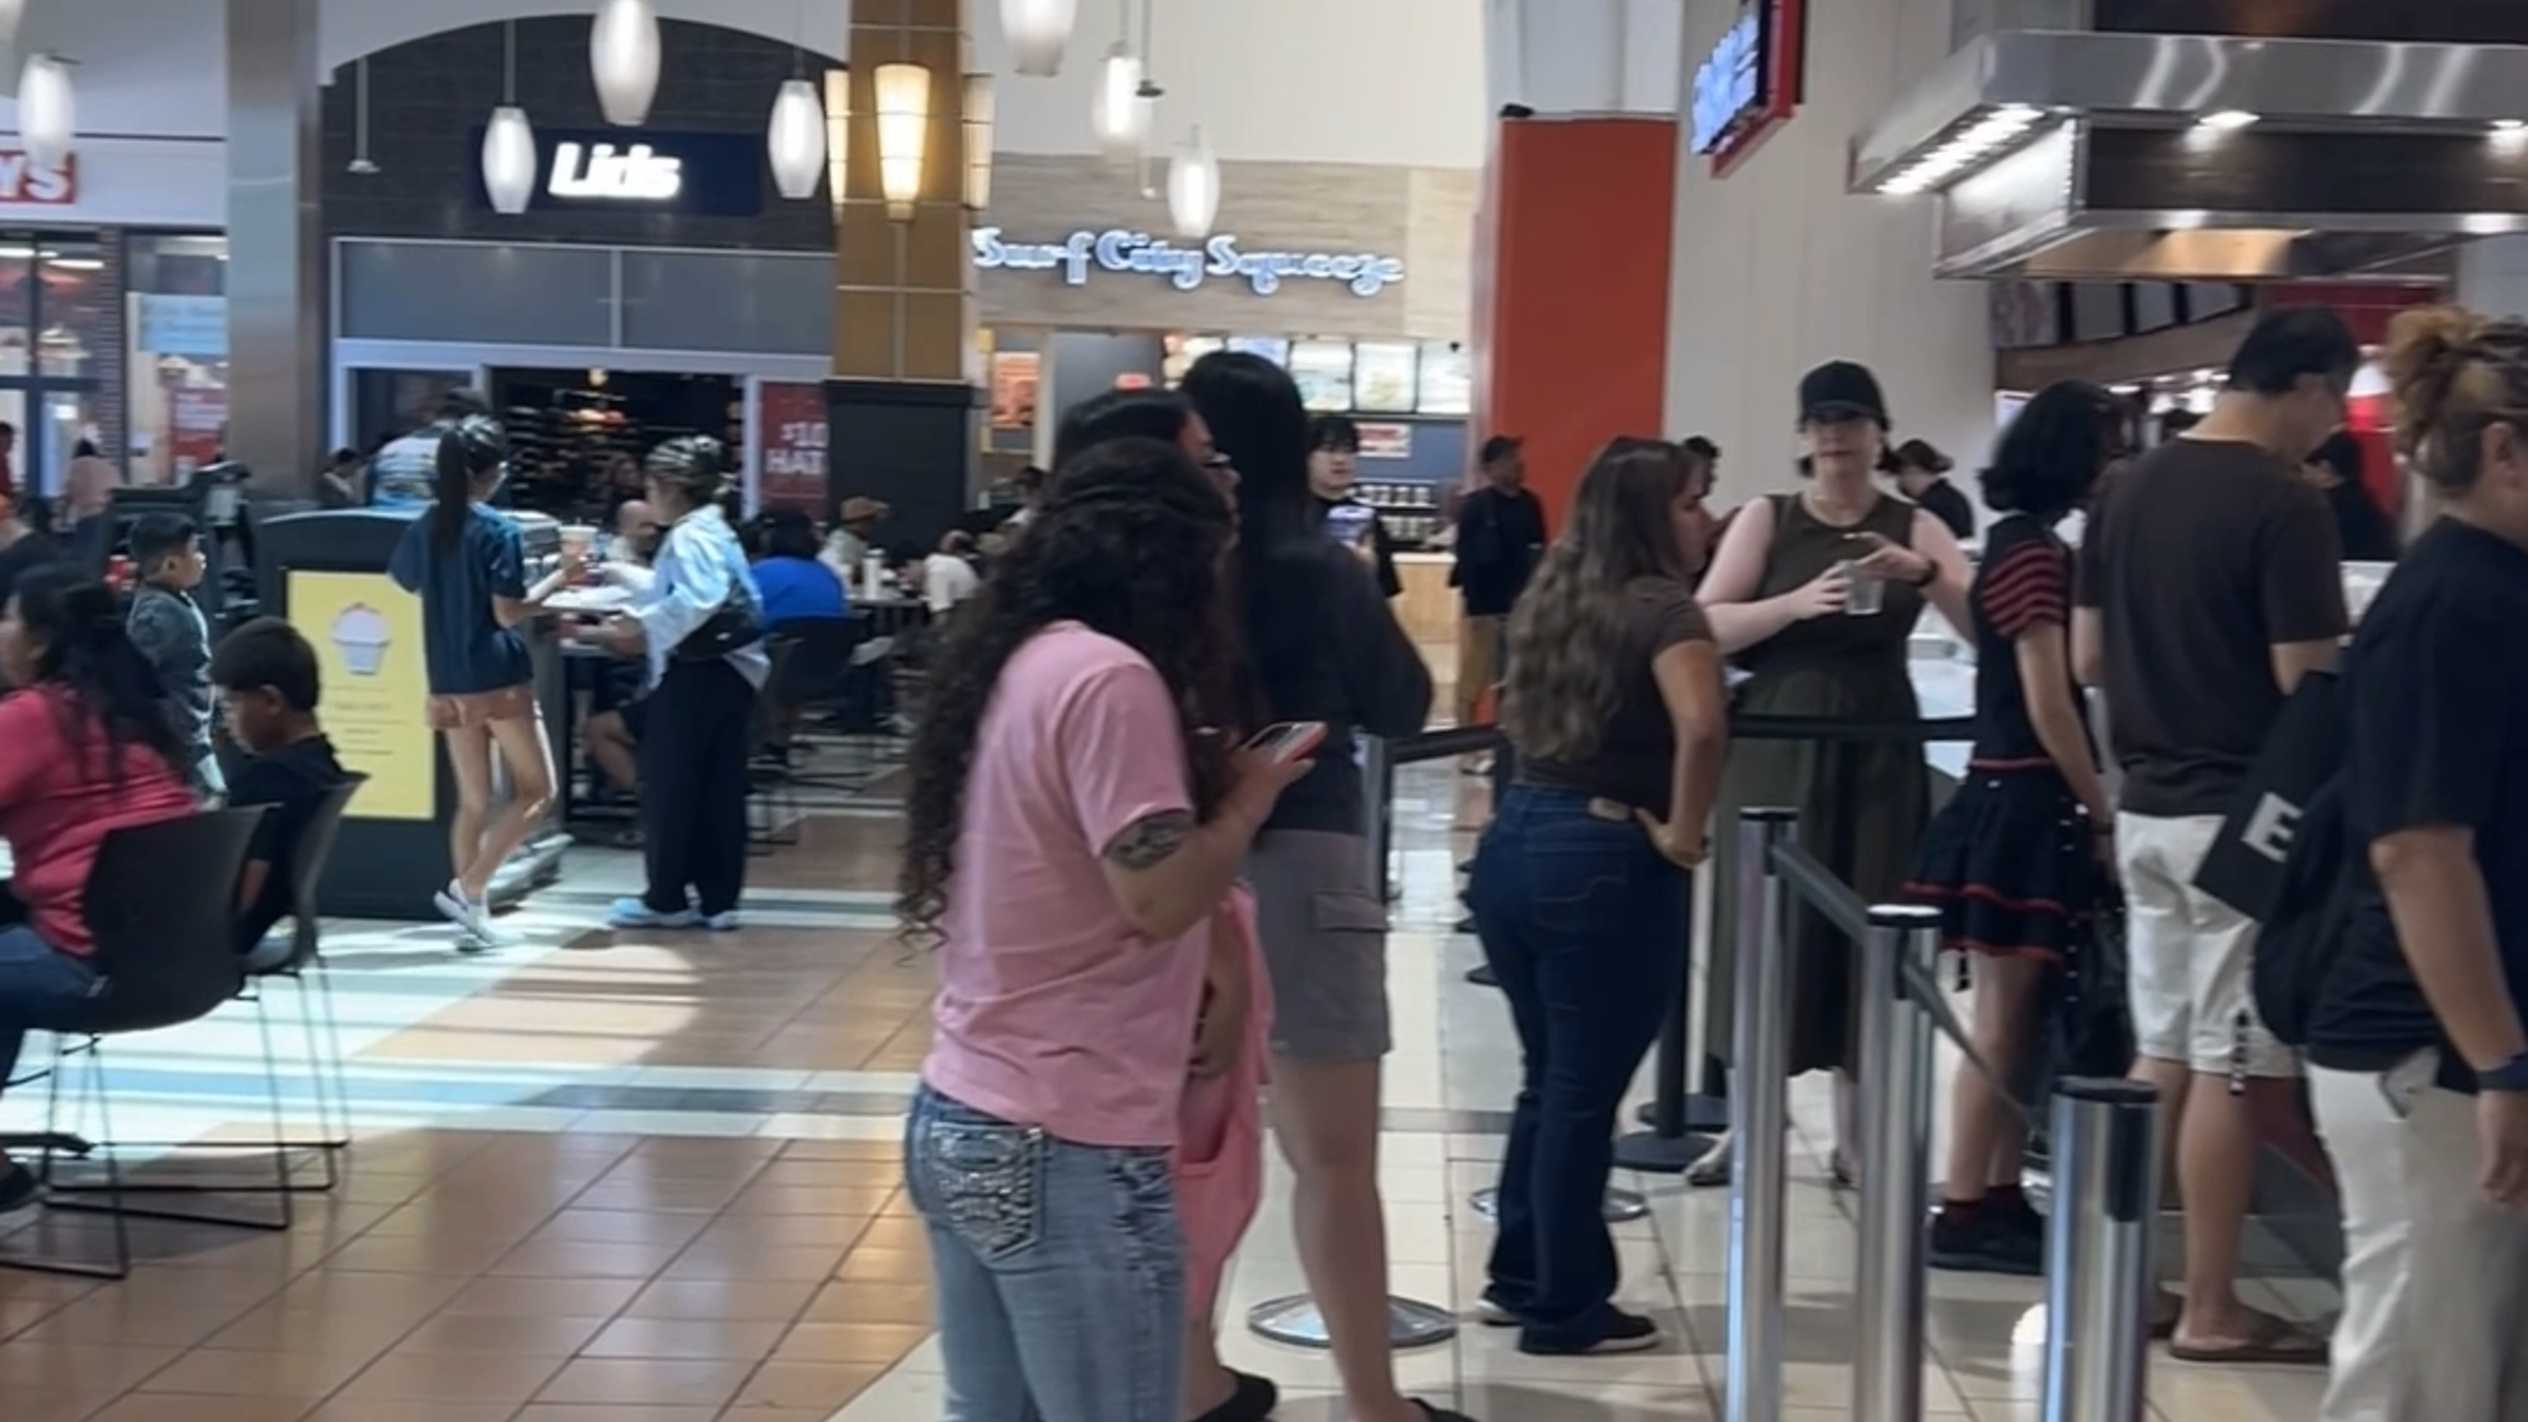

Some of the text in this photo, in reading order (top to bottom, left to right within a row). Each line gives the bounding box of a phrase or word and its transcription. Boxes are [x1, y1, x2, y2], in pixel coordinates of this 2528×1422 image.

[548, 141, 682, 198] Lids
[971, 227, 1405, 297] Surf City Squeeze
